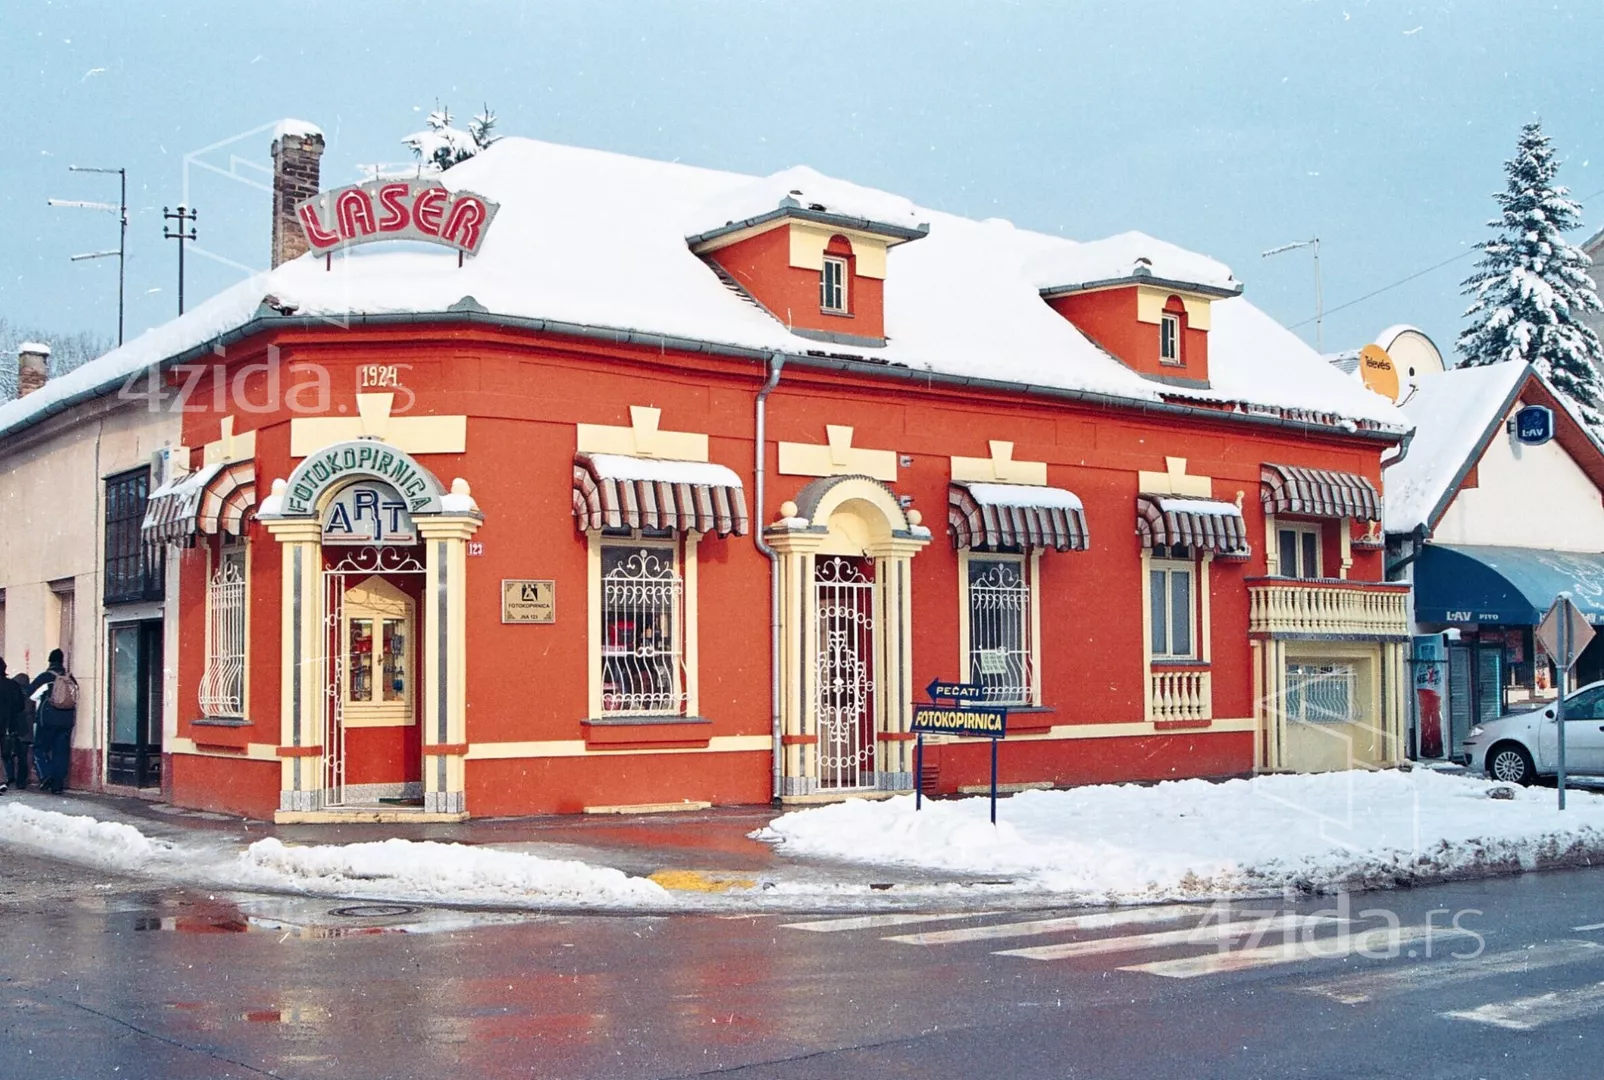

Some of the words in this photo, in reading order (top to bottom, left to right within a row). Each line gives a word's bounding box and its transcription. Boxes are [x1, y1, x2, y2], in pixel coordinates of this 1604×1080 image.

[298, 182, 488, 249] LASER
[288, 447, 432, 513] FOTOKOPIRNICA
[325, 490, 407, 541] ART
[469, 542, 482, 555] 123
[1446, 611, 1472, 622] LAV
[915, 710, 1002, 731] FOTOKOPIRNICA
